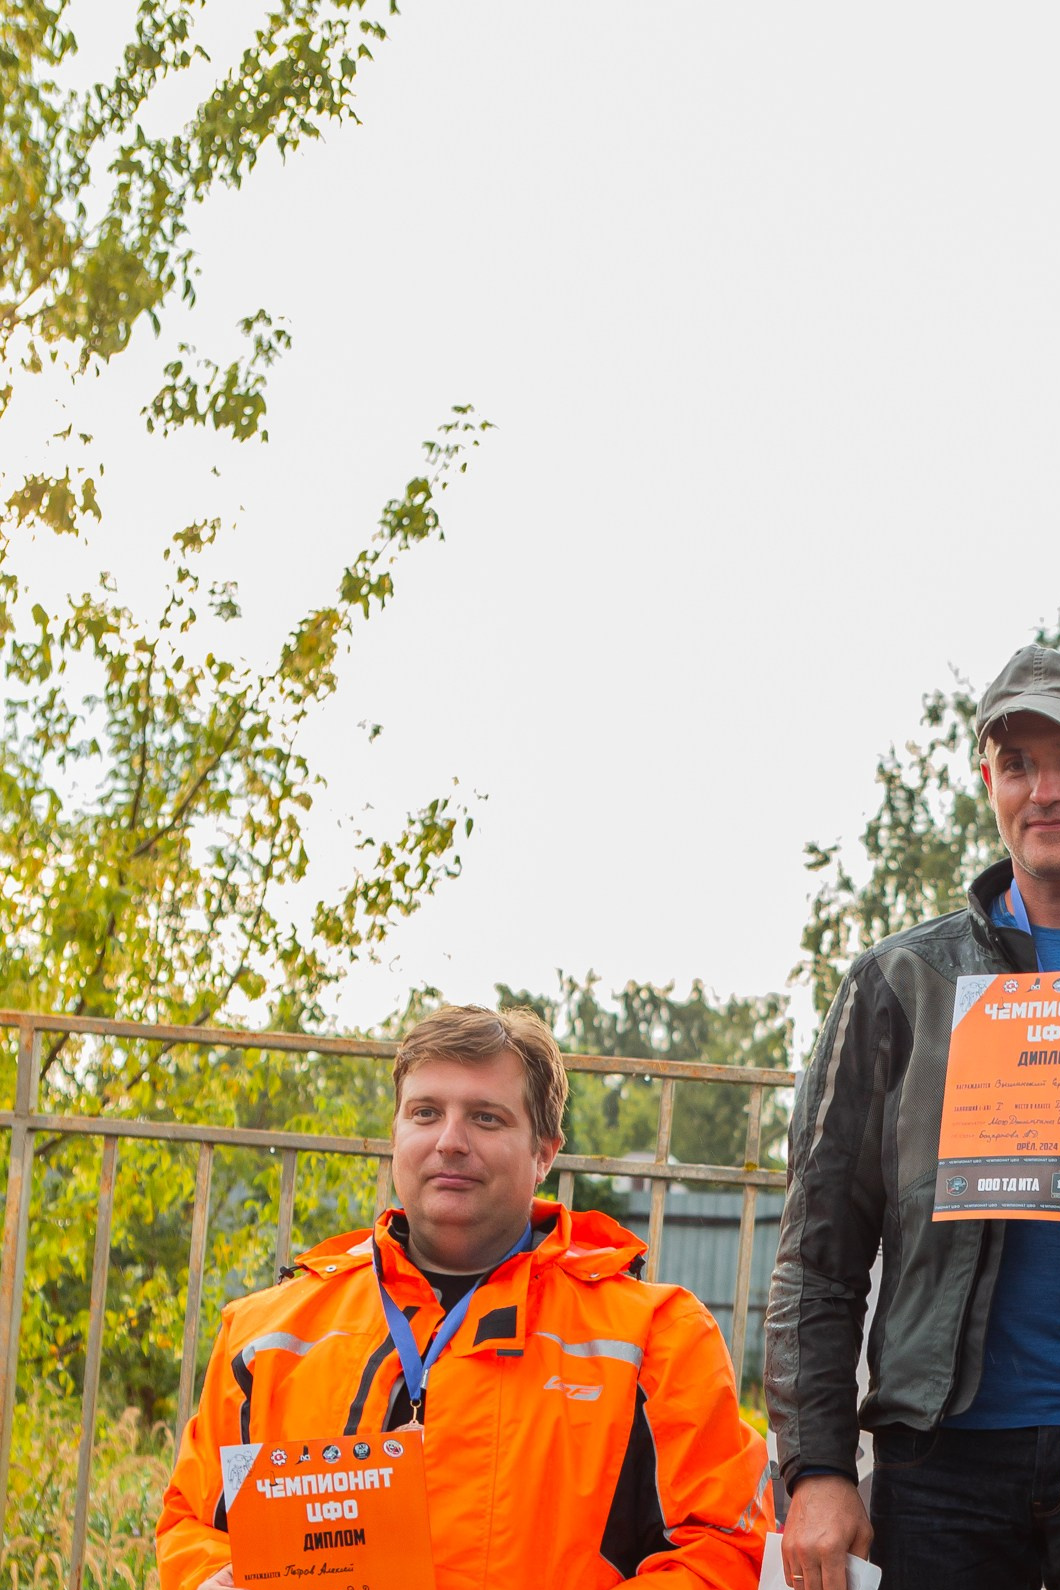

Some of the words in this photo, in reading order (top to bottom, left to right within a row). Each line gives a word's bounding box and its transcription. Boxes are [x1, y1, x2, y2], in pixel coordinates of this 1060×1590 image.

[1039, 1142, 1058, 1150] 2024
[977, 1178, 1000, 1191] ООО
[1001, 1178, 1017, 1191] ТД
[1018, 1177, 1040, 1191] ИТА
[255, 1467, 394, 1500] ЧЕМПИОНАТ
[306, 1498, 358, 1523] ЦФО
[302, 1527, 365, 1551] ДИПЛОМ
